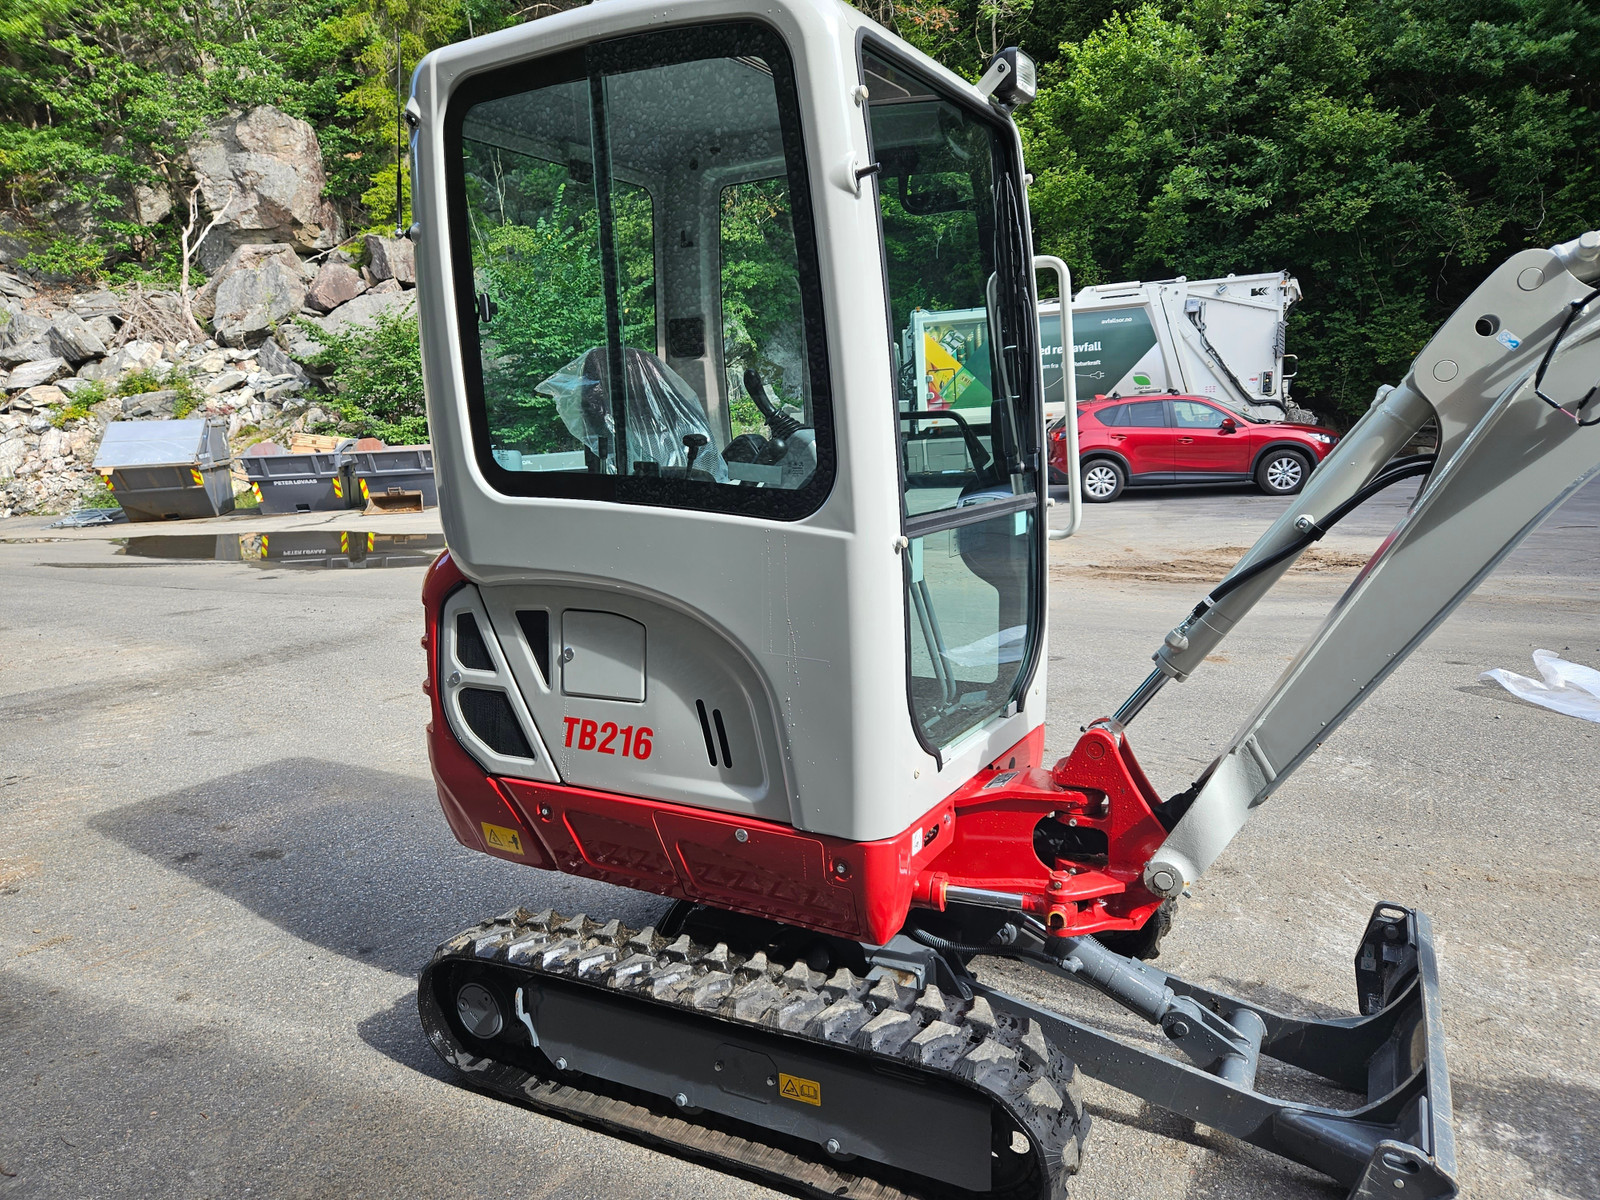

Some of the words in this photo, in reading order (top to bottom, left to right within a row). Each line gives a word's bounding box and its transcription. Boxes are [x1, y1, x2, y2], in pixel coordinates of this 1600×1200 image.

[1040, 346, 1050, 356] ed
[1052, 341, 1102, 354] reavfall
[564, 716, 654, 760] TB216
